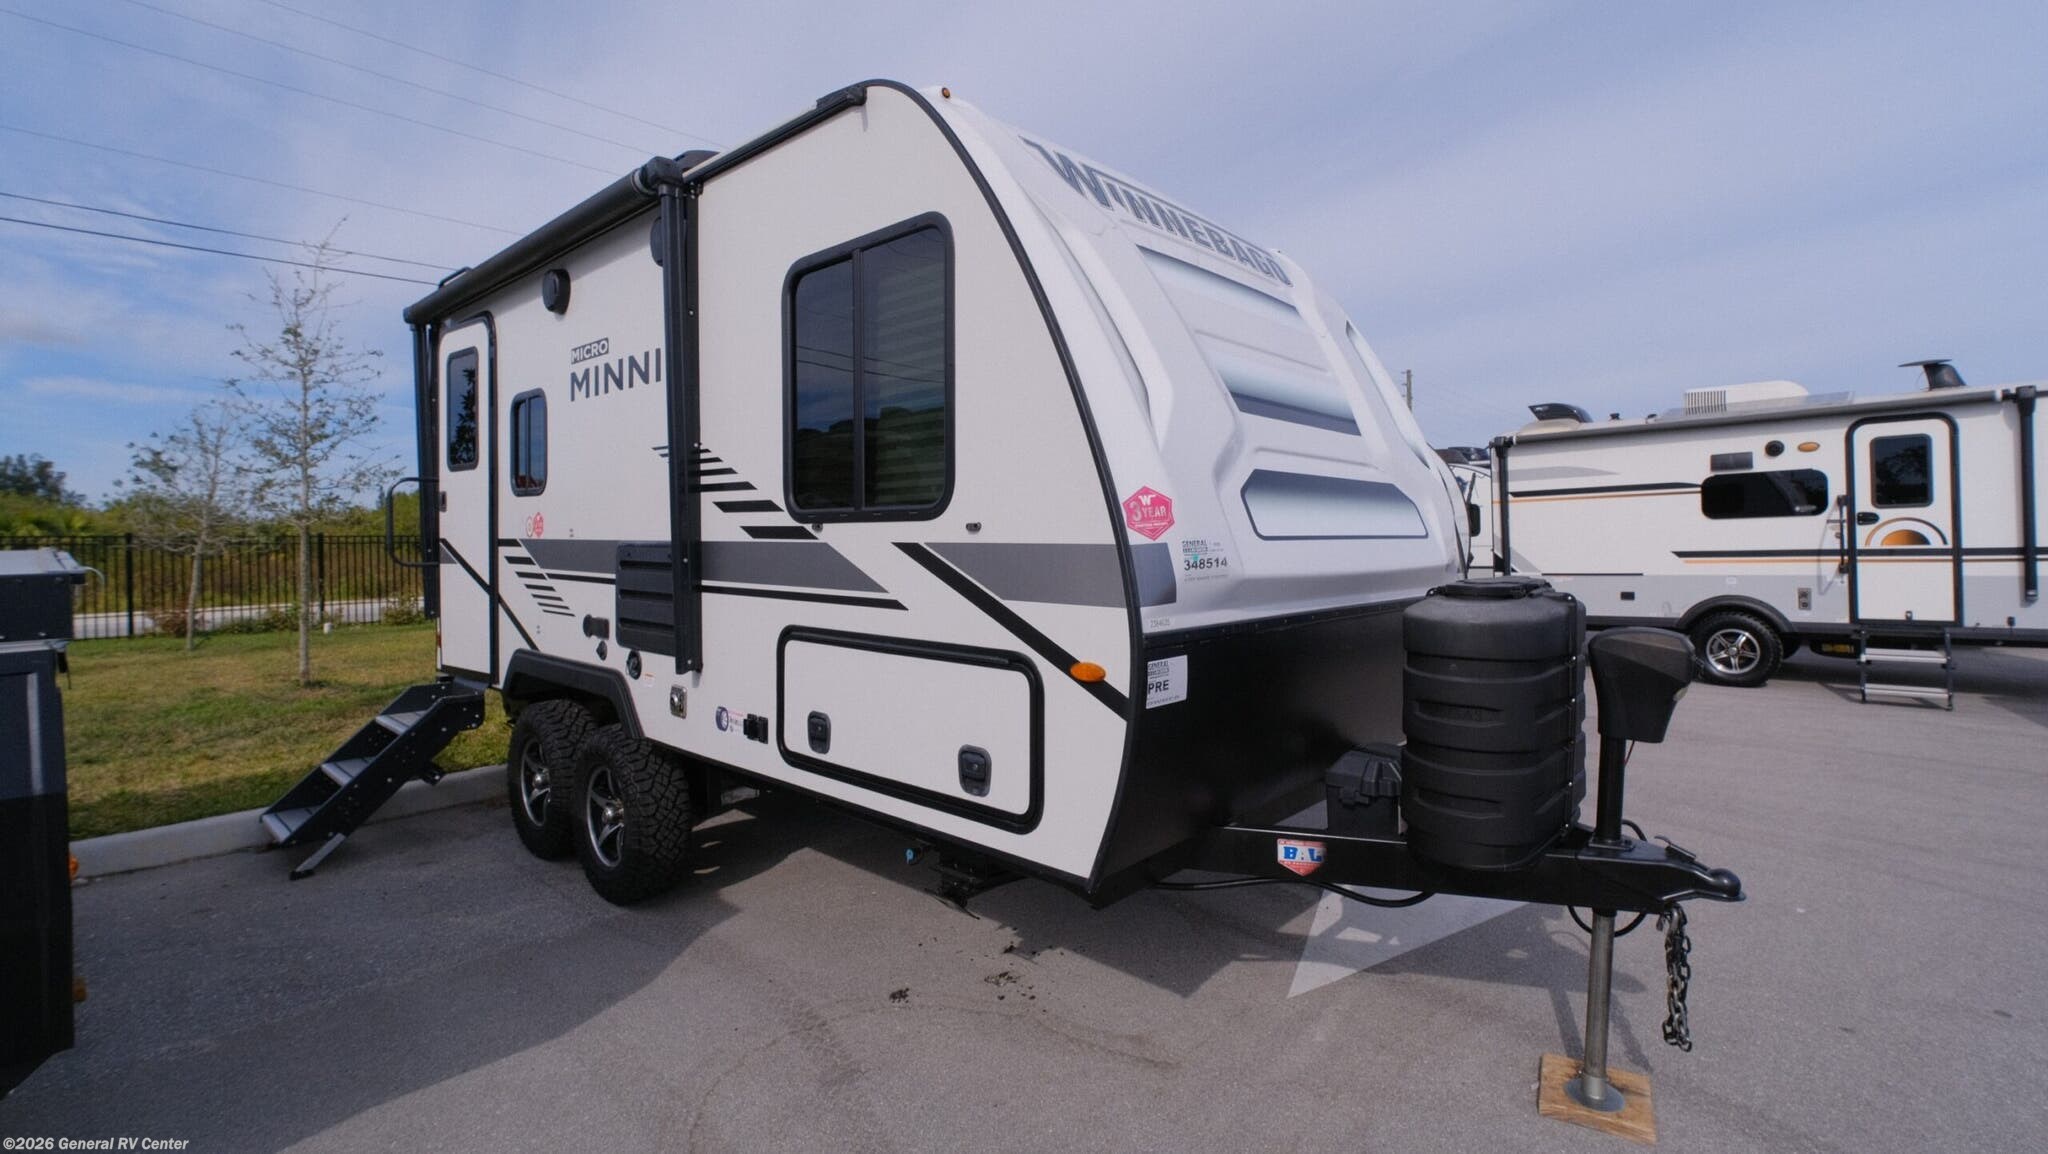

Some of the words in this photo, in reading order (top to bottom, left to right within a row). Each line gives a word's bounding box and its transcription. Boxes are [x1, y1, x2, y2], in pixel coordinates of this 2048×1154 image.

[1018, 135, 1294, 287] WINNEBAGO
[571, 340, 609, 364] MICRO
[570, 347, 662, 402] MINNI
[1129, 501, 1142, 521] 3
[1142, 505, 1168, 518] YEAR
[1183, 557, 1228, 571] 348514
[1148, 679, 1170, 695] PRE
